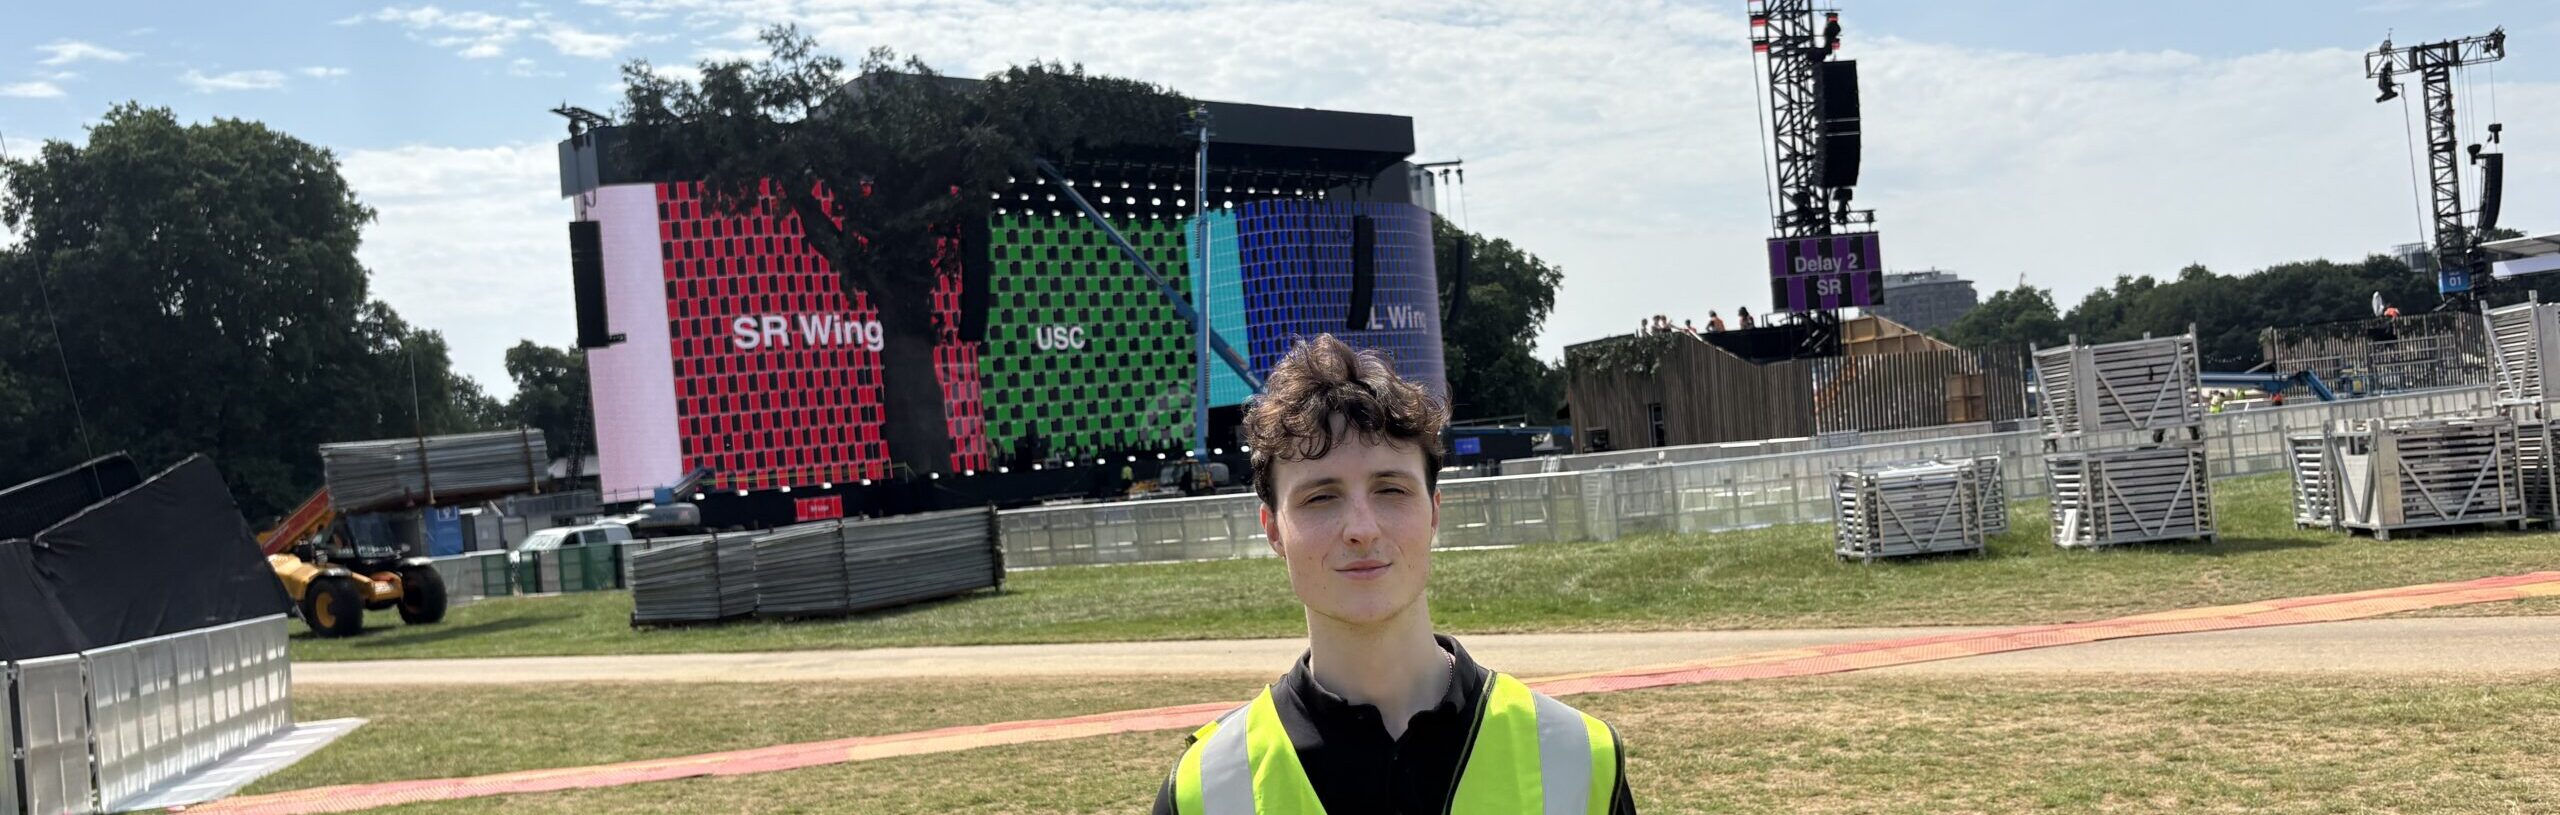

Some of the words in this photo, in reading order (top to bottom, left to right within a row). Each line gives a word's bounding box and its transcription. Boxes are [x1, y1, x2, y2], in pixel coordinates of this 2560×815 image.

[1794, 256, 1842, 274] Delay
[1847, 253, 1859, 269] 2
[1816, 278, 1842, 296] SR
[2449, 276, 2462, 287] 01
[1365, 305, 1385, 330] L
[733, 315, 790, 349] SR
[799, 314, 885, 351] Wing
[1036, 326, 1086, 350] USC
